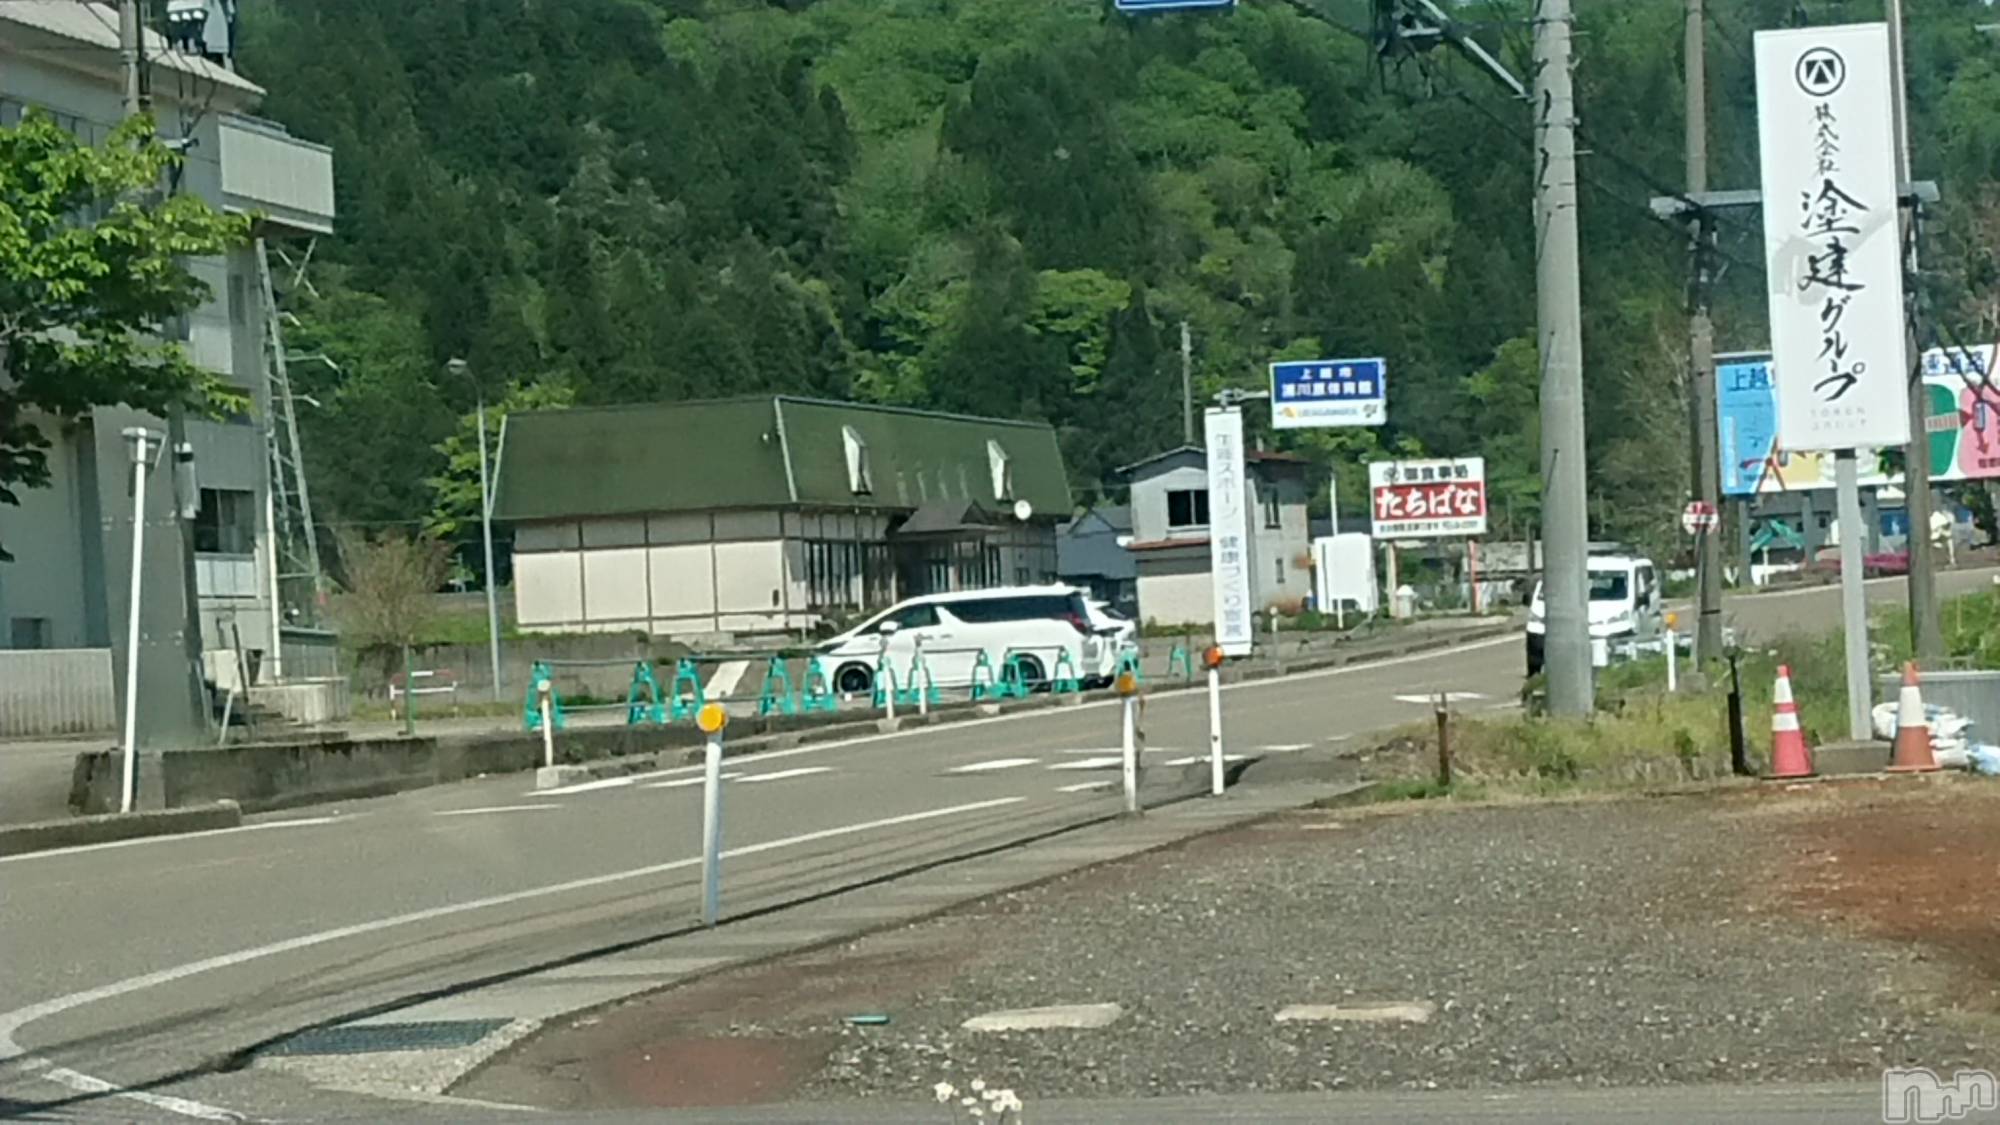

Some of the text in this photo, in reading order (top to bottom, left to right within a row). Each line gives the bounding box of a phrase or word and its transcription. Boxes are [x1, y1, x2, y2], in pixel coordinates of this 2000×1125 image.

[1797, 178, 1871, 402] 塗建グループ
[1727, 366, 1776, 393] 上越
[1376, 485, 1479, 518] たちばな
